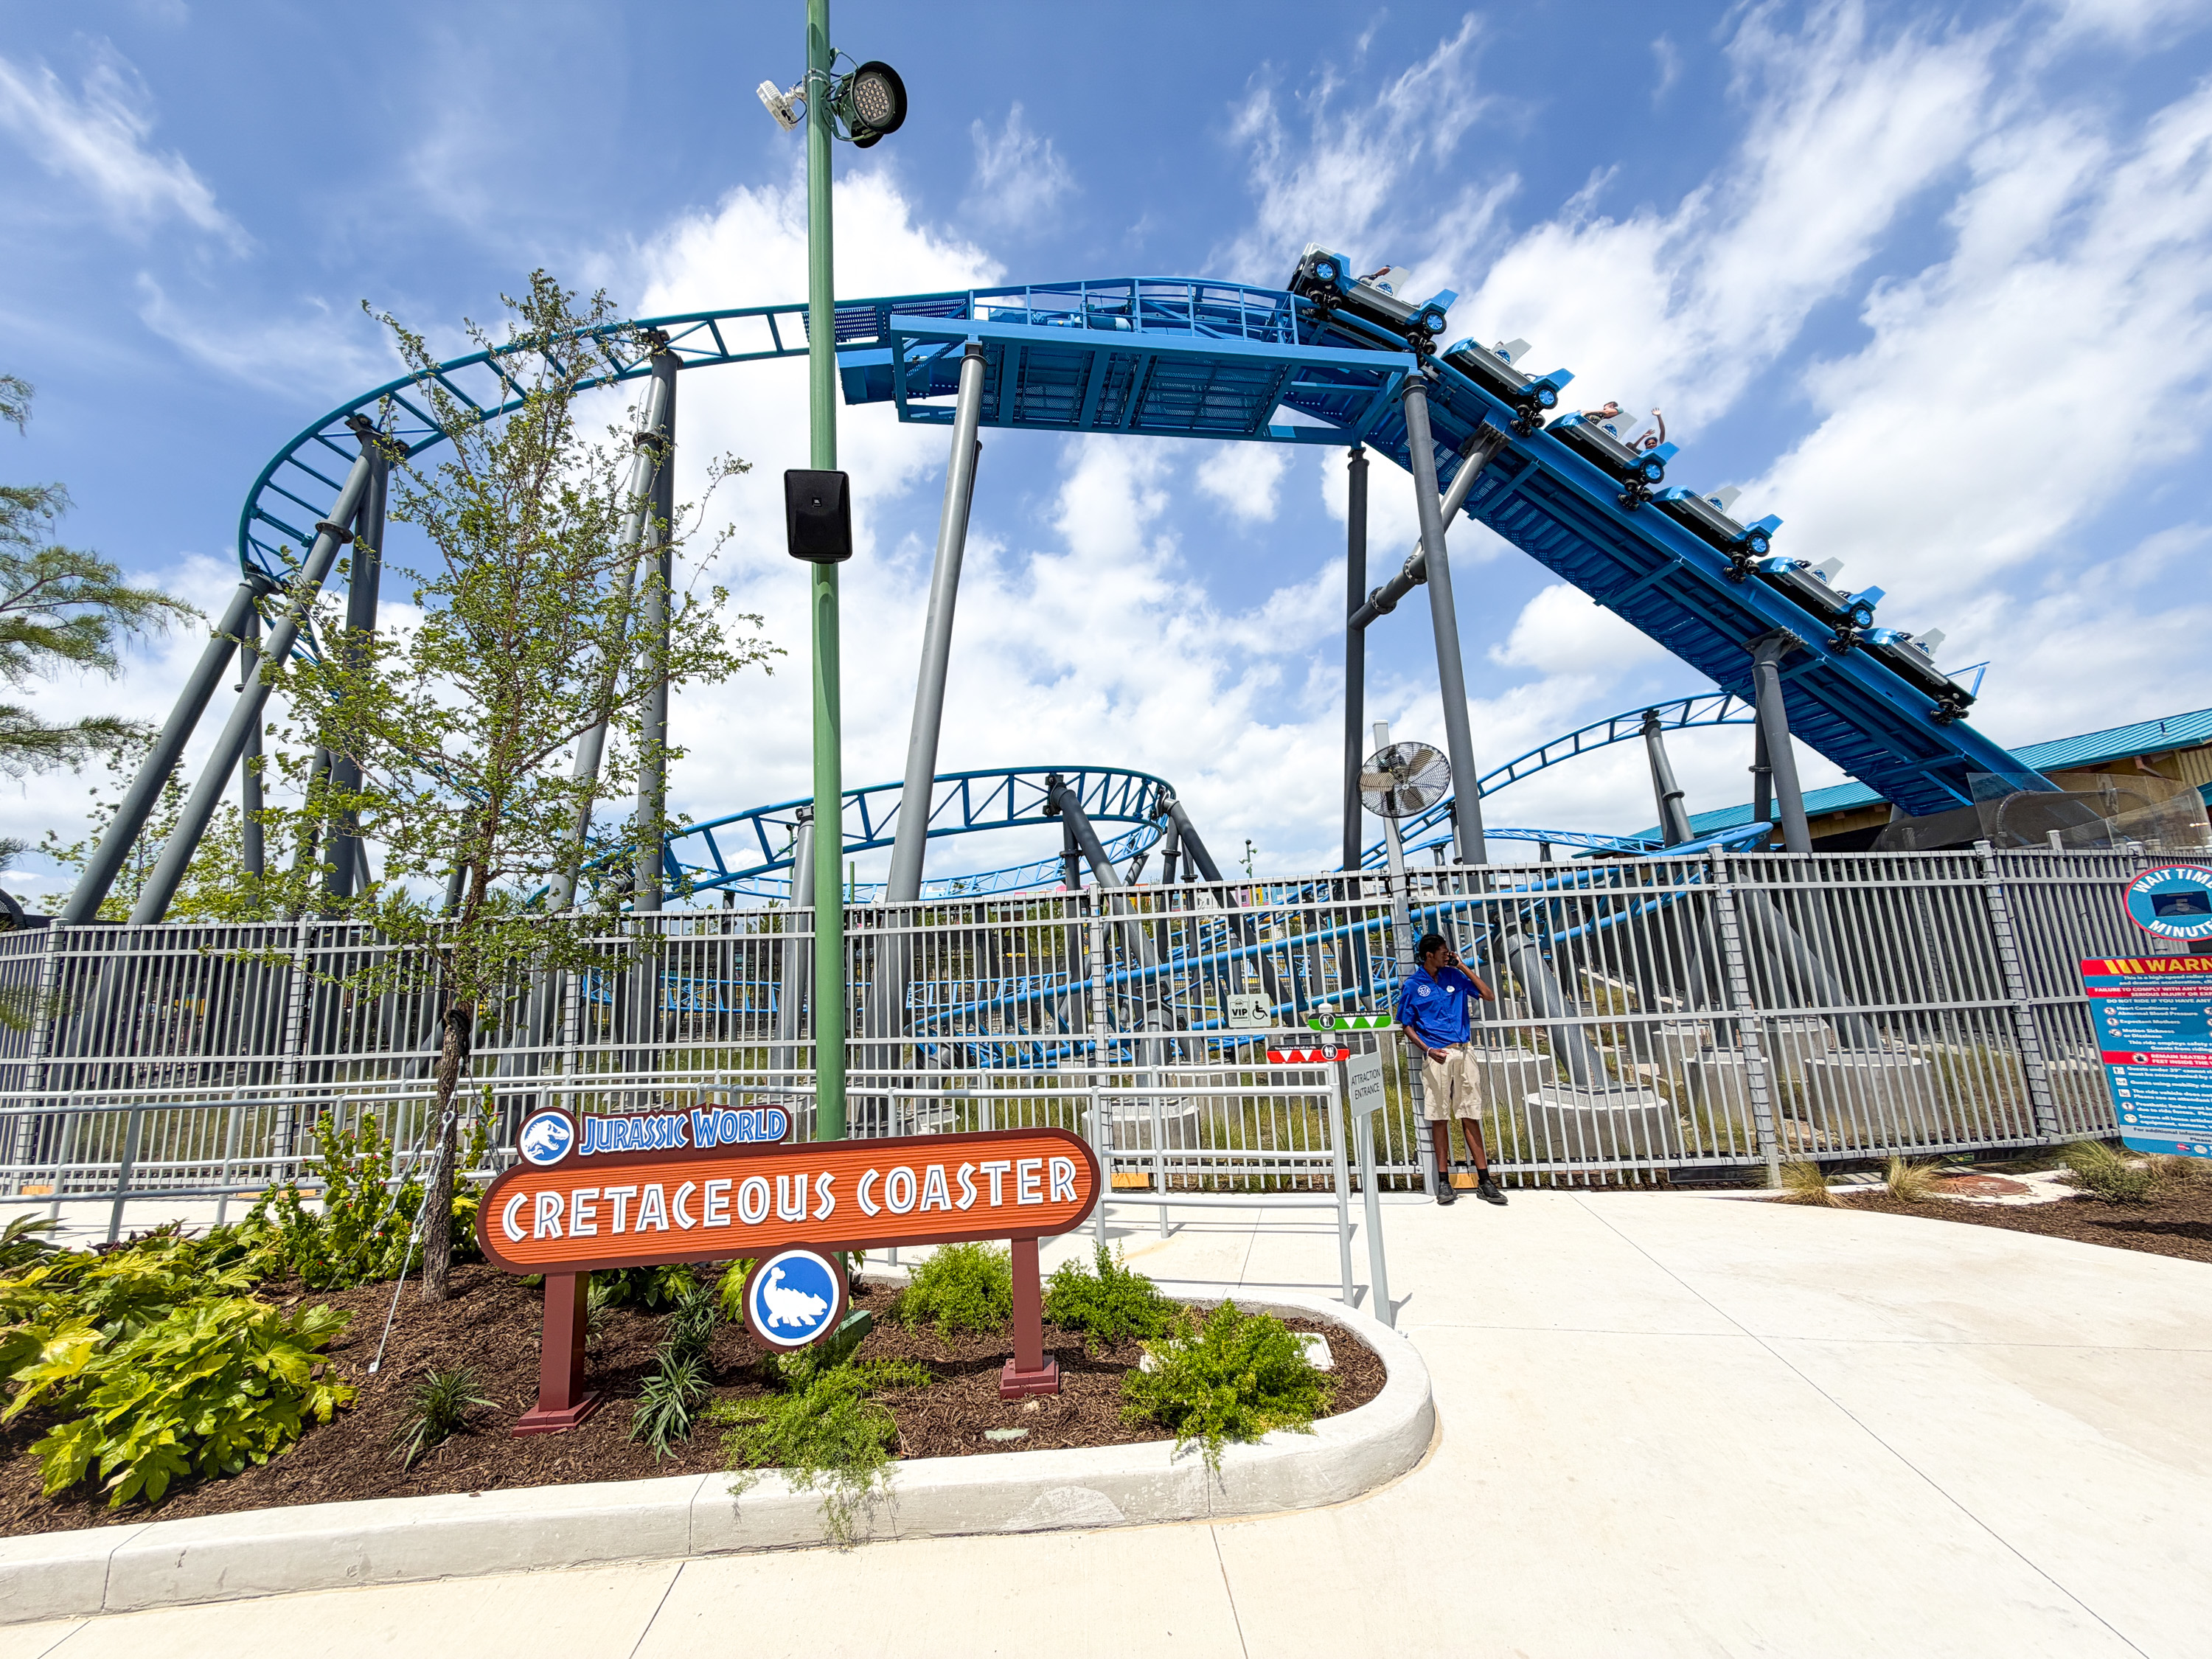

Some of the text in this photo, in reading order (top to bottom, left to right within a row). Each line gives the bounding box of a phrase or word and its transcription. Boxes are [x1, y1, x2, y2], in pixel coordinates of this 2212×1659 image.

[2132, 869, 2171, 893] WAIT
[2148, 918, 2212, 937] MINUTE
[1351, 1068, 1381, 1086] ATTRACTION
[1354, 1082, 1380, 1099] ENTRANCE
[579, 1107, 787, 1156] JURASSIC WORLD
[501, 1155, 1079, 1244] CRETACEOUS COASTER
